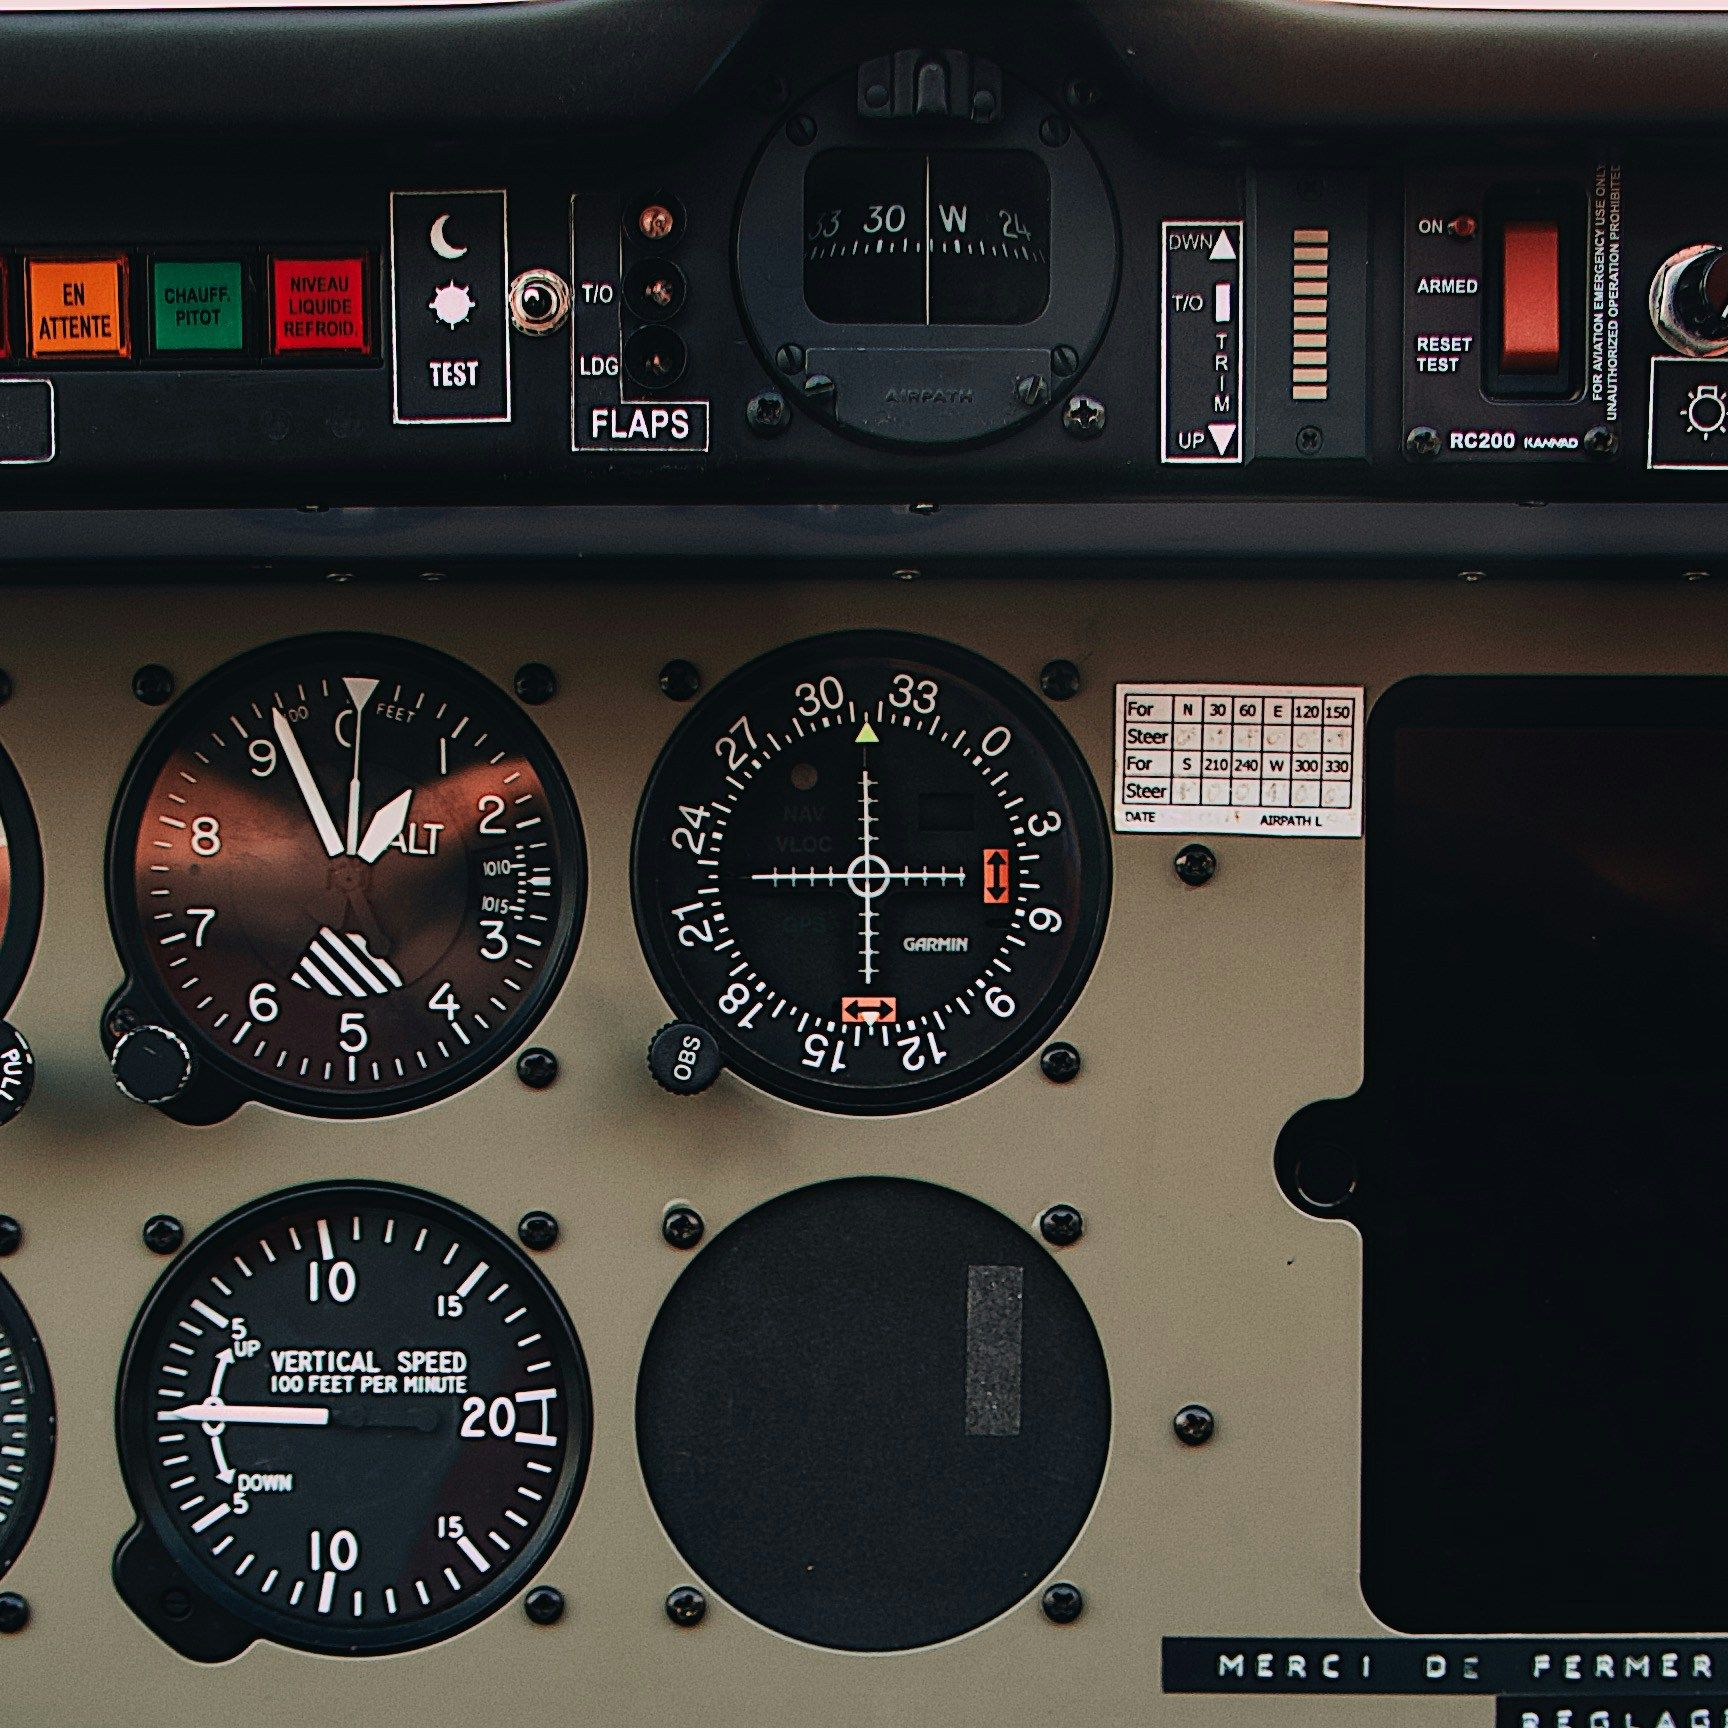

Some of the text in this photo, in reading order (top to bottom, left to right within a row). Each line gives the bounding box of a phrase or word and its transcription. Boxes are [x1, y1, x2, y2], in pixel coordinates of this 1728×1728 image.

[864, 206, 967, 232] 30 W
[1419, 219, 1443, 234] ON
[1170, 235, 1212, 251] DWN
[290, 277, 349, 293] NIVEAU
[582, 284, 613, 303] T/O
[1417, 279, 1478, 293] ARMED
[63, 283, 85, 306] EN
[164, 287, 230, 305] CHAUFF.
[1173, 295, 1203, 311] T/O
[288, 298, 351, 316] LIQUIDE
[39, 313, 112, 340] ATTENTE
[176, 309, 220, 326] PITOT
[283, 320, 357, 338] REFROID.
[1417, 337, 1472, 352] RESET
[581, 357, 619, 375] LDG
[1417, 357, 1460, 372] TEST
[430, 362, 478, 386] TEST
[592, 410, 689, 439] FLAPS
[1179, 433, 1204, 449] UP
[1450, 432, 1515, 449] RC200
[796, 677, 843, 717] 30
[889, 675, 938, 714] 33
[376, 703, 416, 723] FEET
[1128, 702, 1349, 719] For N 30 60 E 120 150
[716, 716, 759, 768] 27
[1128, 729, 1168, 744] Steer
[1127, 757, 1348, 772] For S 210 240 W 300 330
[904, 937, 968, 951] GARMIN
[674, 1036, 700, 1080] OBS
[310, 1262, 355, 1301] 10
[437, 1296, 462, 1316] 15
[235, 1342, 260, 1357] UP
[272, 1352, 466, 1372] VERTICAL SPEED
[271, 1376, 466, 1393] 100 FEET PER MINUTE
[461, 1397, 515, 1437] 20
[238, 1475, 291, 1491] DOWN
[1218, 1655, 1370, 1678] MERCI
[1426, 1655, 1479, 1678] DE
[1534, 1655, 1712, 1678] FERMER
